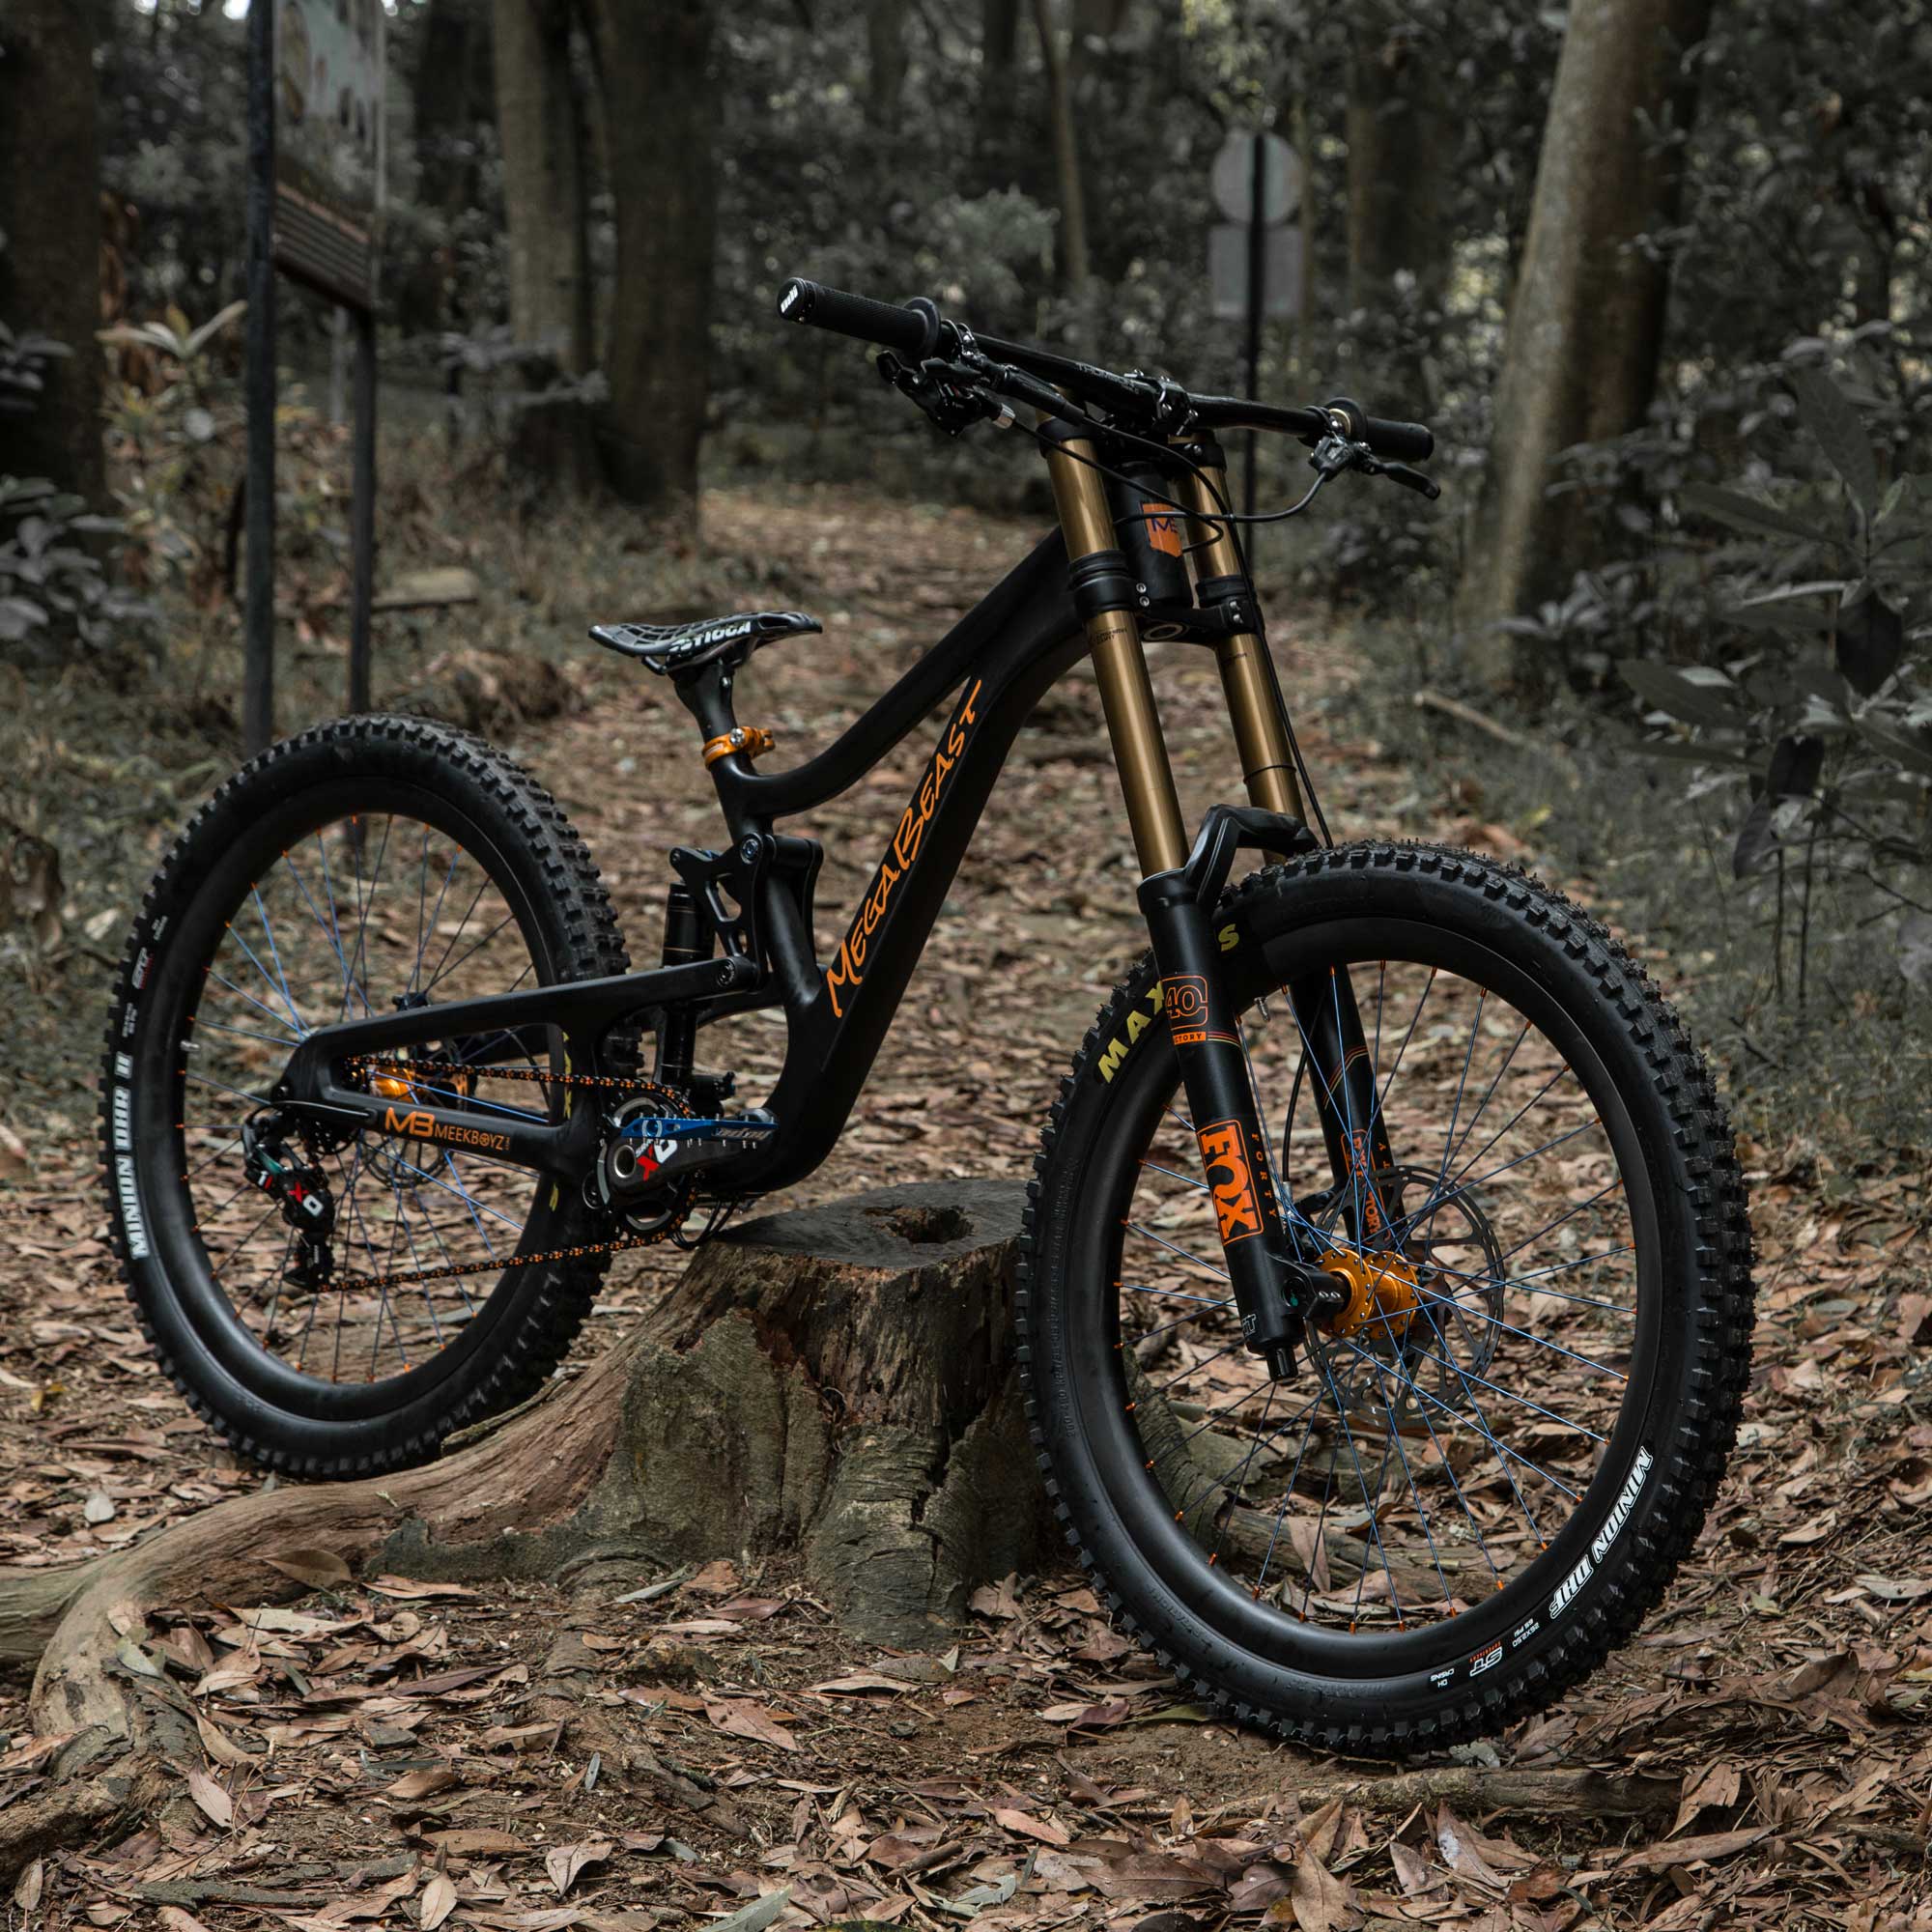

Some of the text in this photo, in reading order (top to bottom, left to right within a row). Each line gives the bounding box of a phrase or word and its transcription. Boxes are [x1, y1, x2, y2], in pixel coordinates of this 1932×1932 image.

[112, 1085, 132, 1151] DHR
[384, 1106, 435, 1137] MB
[114, 1154, 151, 1261] MINION
[1200, 1124, 1258, 1240] FOX
[1251, 1132, 1278, 1218] FORTY
[1549, 1445, 1654, 1620] MINION DHF
[1469, 1646, 1503, 1677] ST
